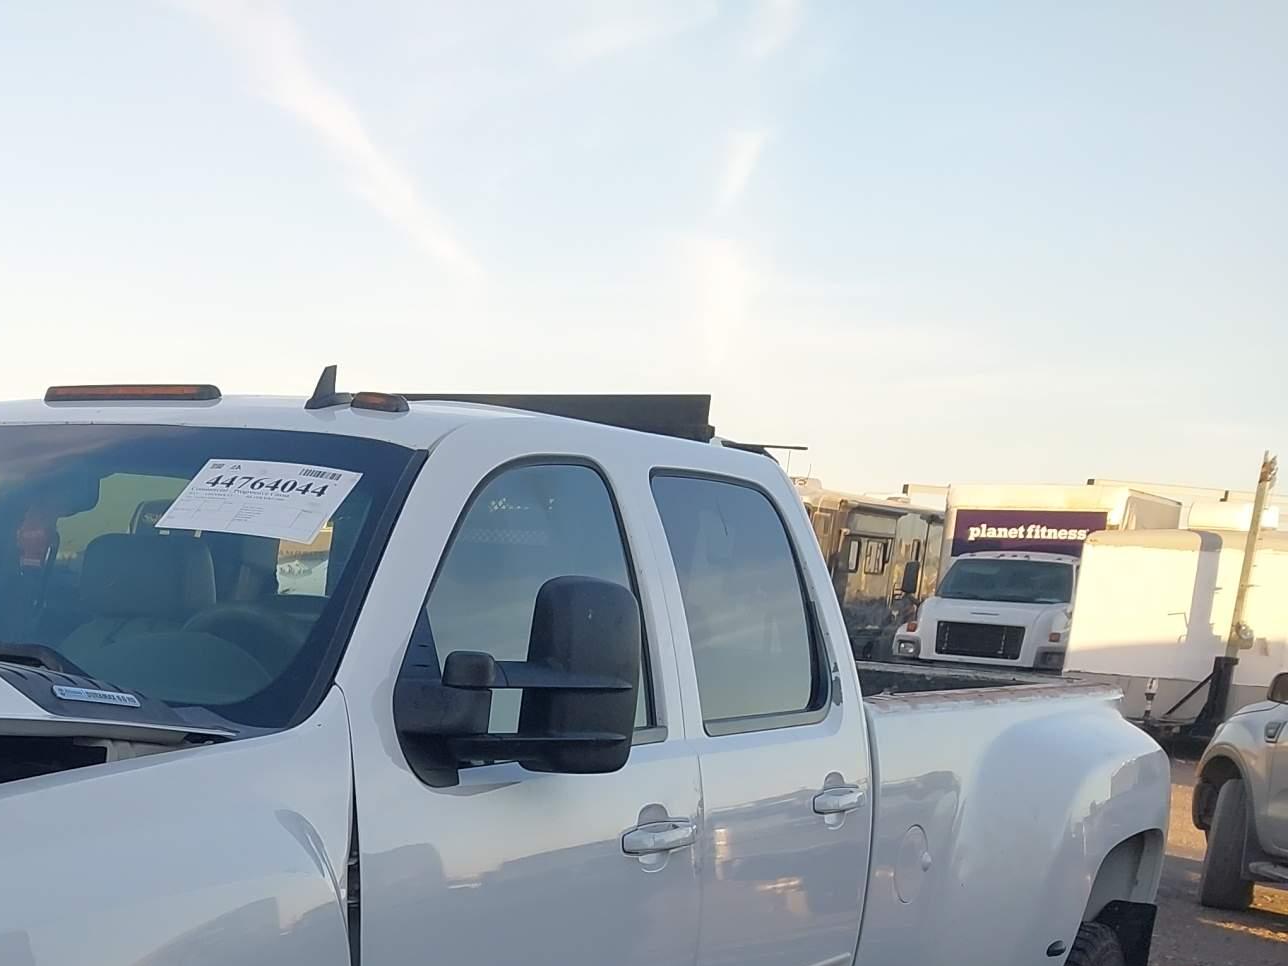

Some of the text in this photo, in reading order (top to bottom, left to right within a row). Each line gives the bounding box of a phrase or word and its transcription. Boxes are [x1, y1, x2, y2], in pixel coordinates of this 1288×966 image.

[205, 474, 329, 498] 44764044
[968, 523, 1087, 541] planet fitness
